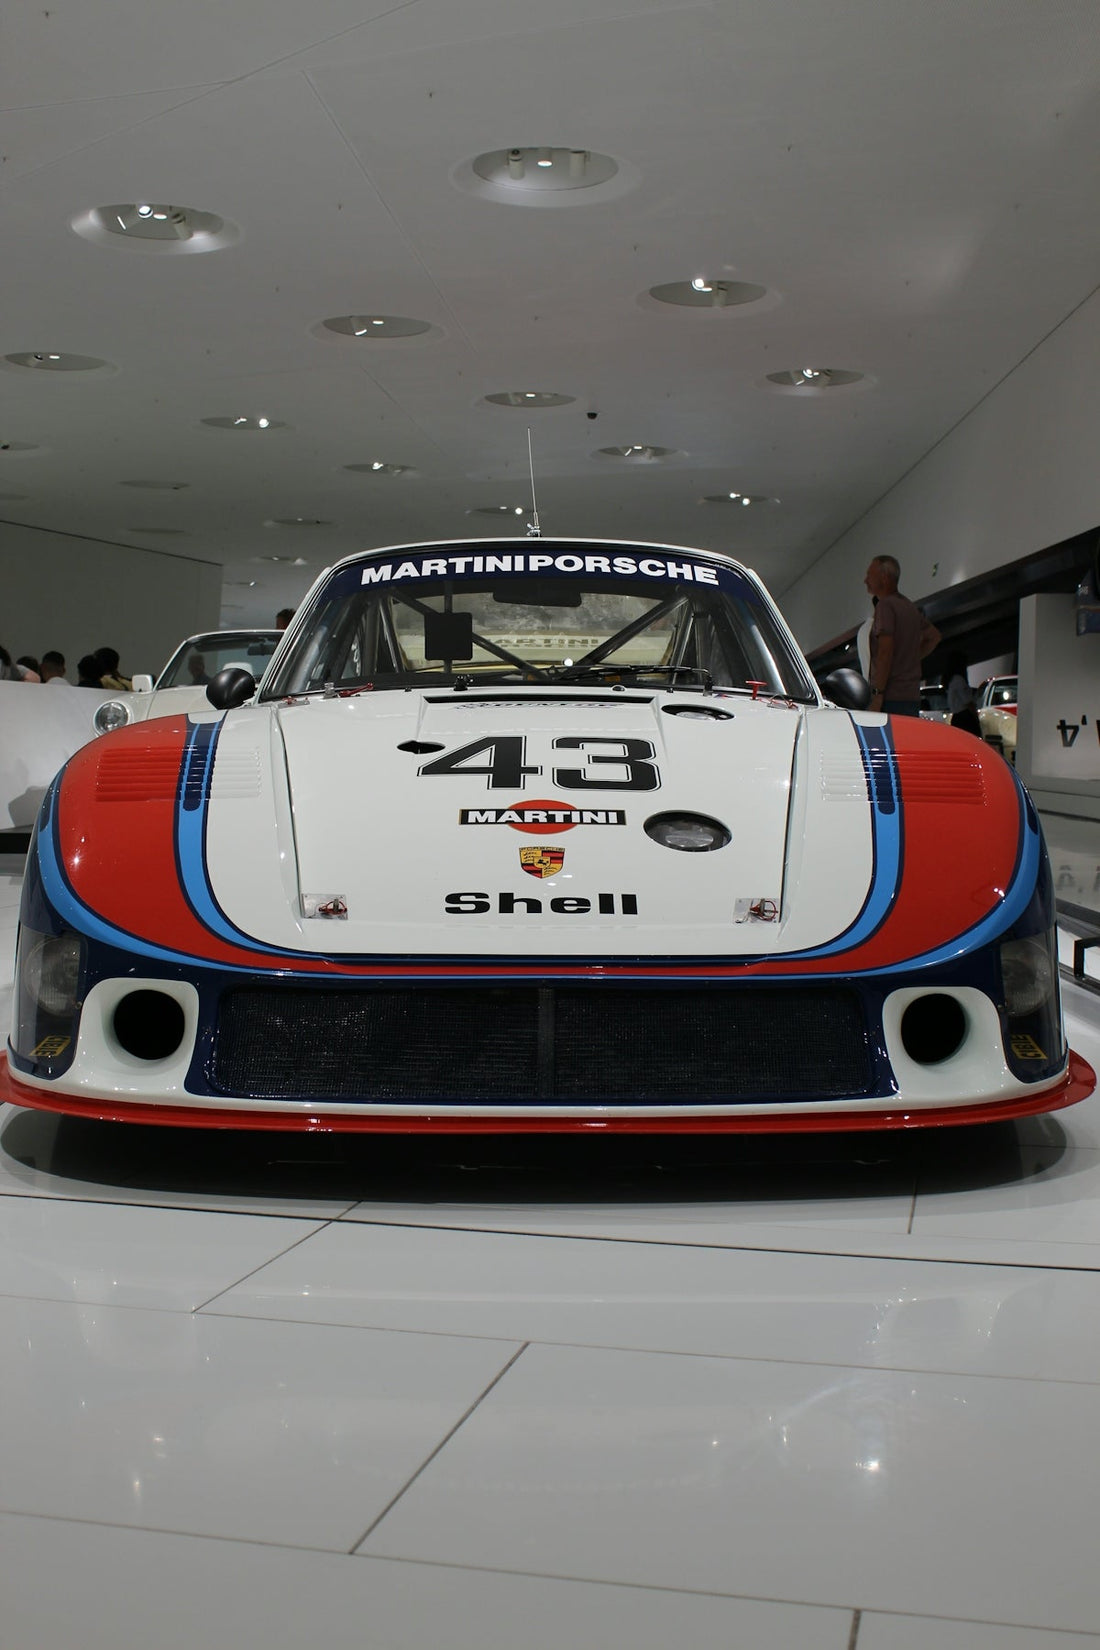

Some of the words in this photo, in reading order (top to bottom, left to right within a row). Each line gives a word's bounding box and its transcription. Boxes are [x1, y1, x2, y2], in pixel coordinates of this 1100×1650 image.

[487, 638, 599, 649] ARTINI
[416, 735, 662, 792] 43
[468, 810, 618, 824] MARTINI
[445, 892, 638, 916] Shell
